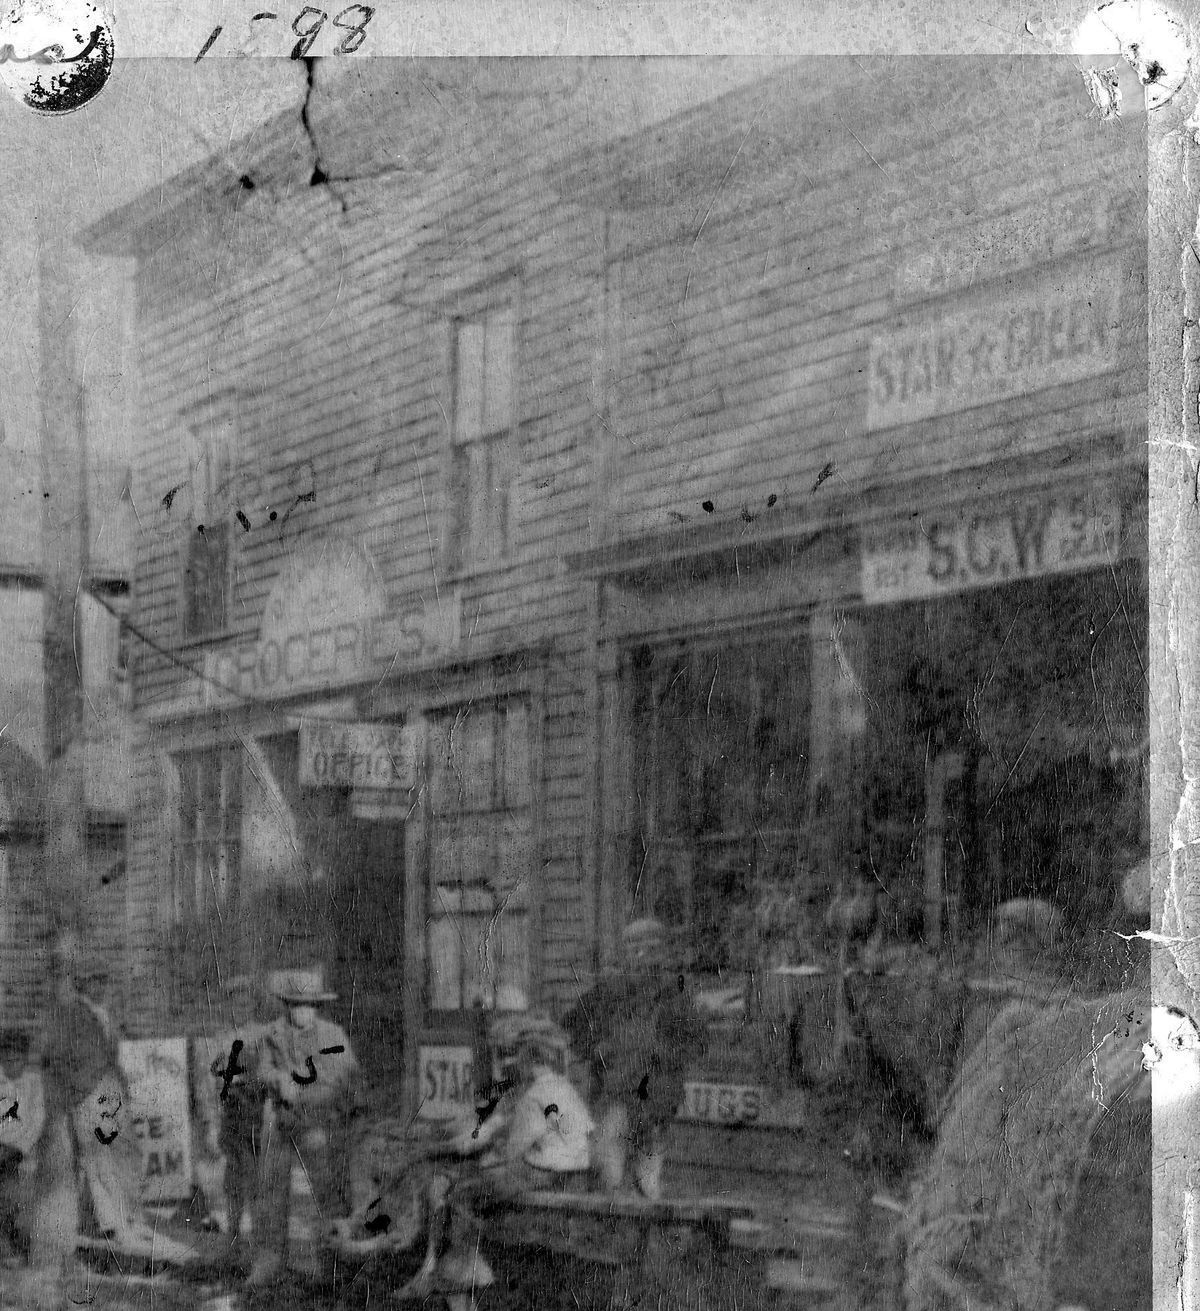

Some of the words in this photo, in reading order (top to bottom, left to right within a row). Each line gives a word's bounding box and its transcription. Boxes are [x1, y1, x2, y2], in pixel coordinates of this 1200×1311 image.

[313, 750, 410, 783] OFFICE
[691, 1086, 761, 1121] UGS
[130, 1116, 165, 1140] CE
